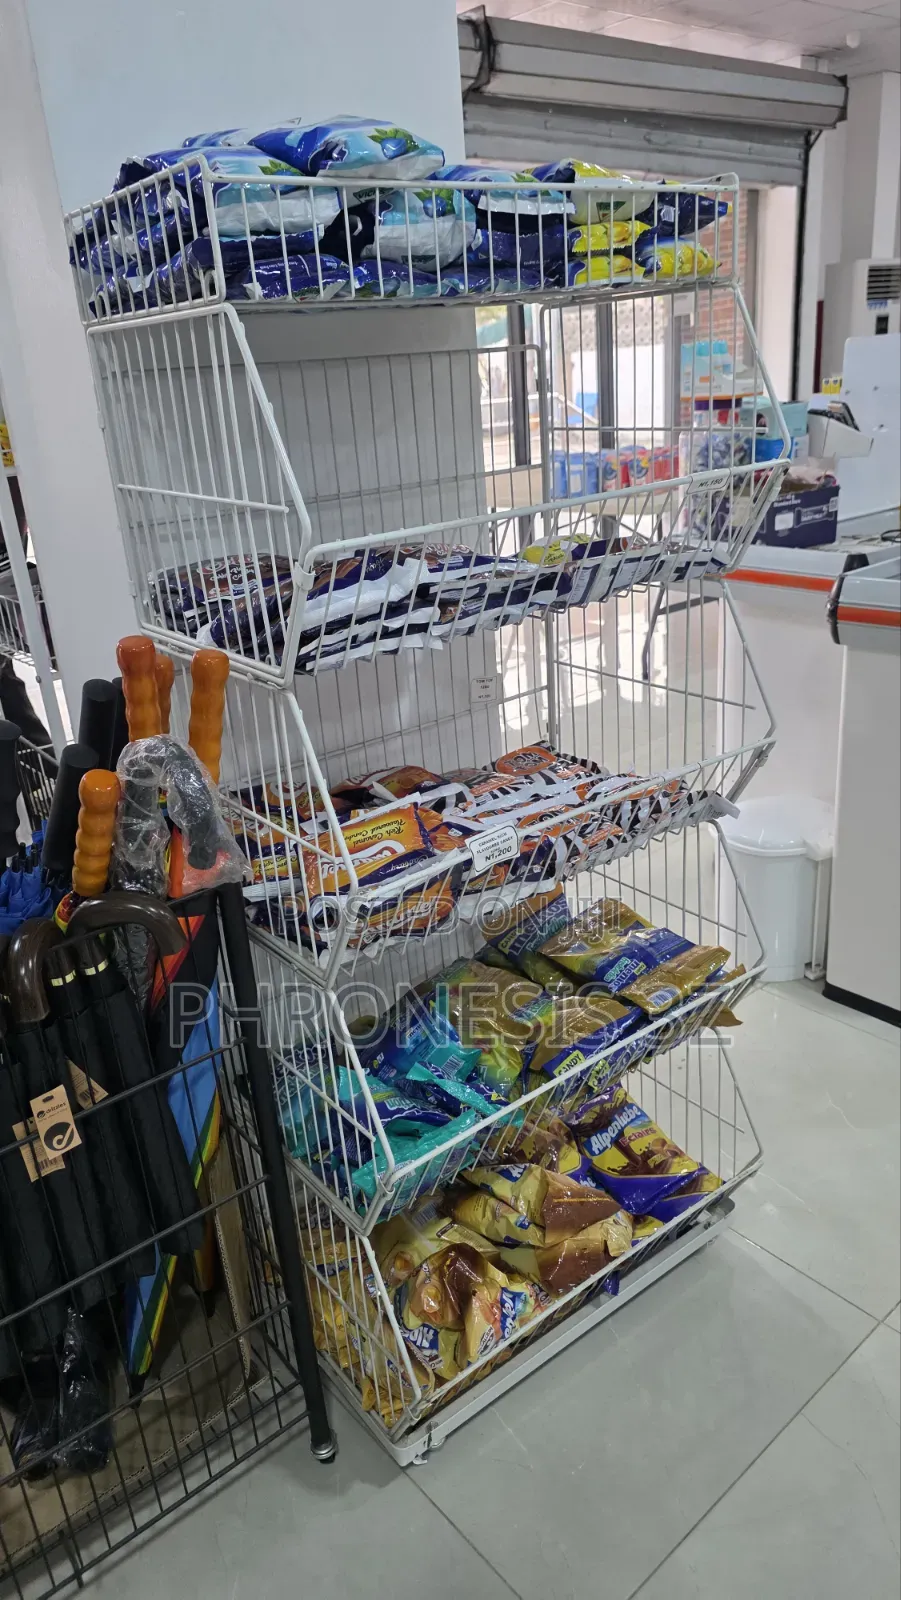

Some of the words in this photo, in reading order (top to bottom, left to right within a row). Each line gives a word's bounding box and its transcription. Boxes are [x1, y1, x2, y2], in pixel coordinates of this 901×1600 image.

[370, 819, 406, 833] Flavoured
[386, 826, 404, 836] Rich
[353, 832, 384, 848] Caramel
[608, 958, 641, 992] mentos
[590, 1105, 641, 1155] Alpenliebe
[619, 1127, 657, 1147] Eclairs
